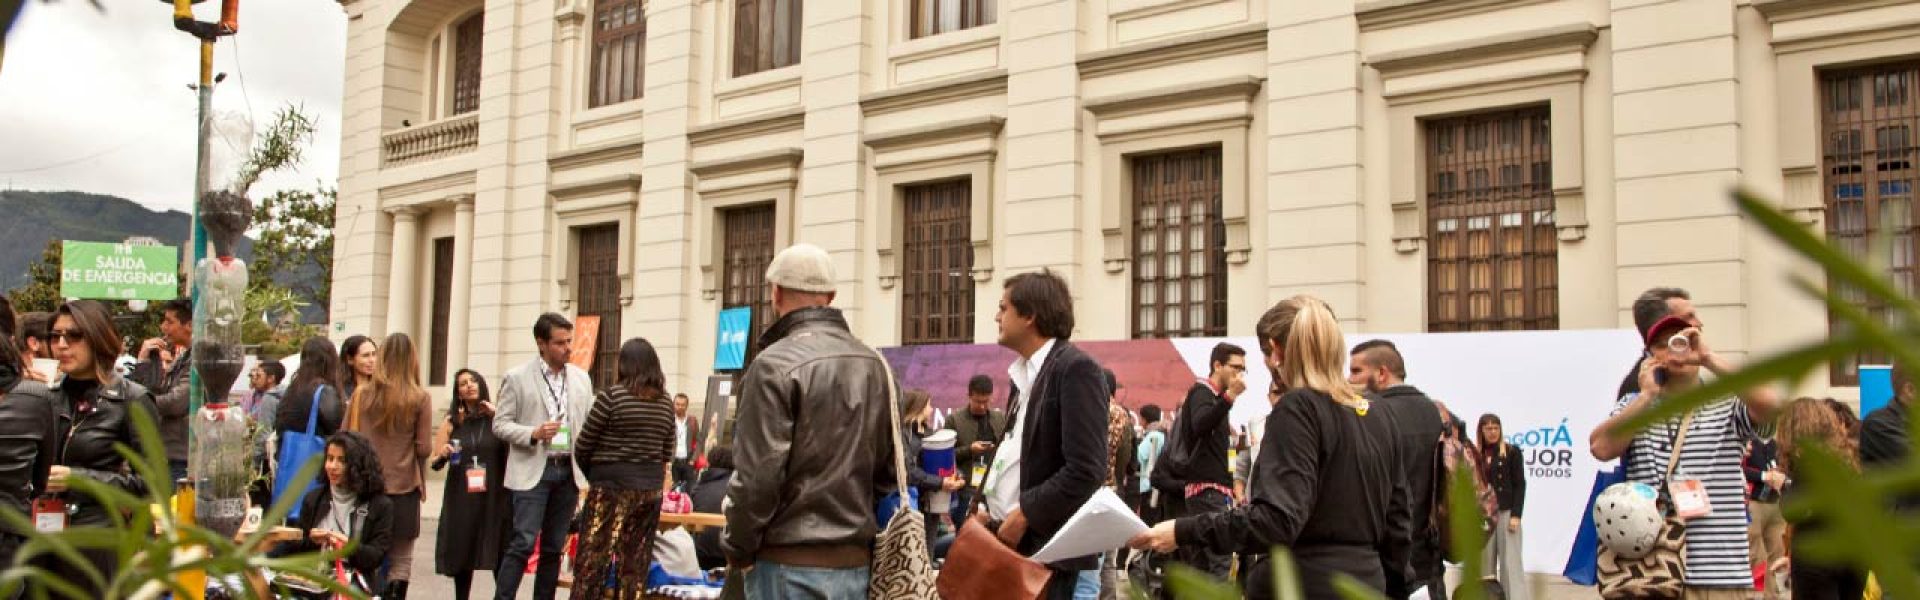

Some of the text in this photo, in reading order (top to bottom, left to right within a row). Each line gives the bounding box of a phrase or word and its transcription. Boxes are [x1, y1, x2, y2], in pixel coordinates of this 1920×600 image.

[95, 255, 145, 270] SALIDA
[63, 269, 177, 285] DE EMERGENCIA
[1520, 449, 1573, 466] JOR
[1529, 467, 1572, 478] TODOS
